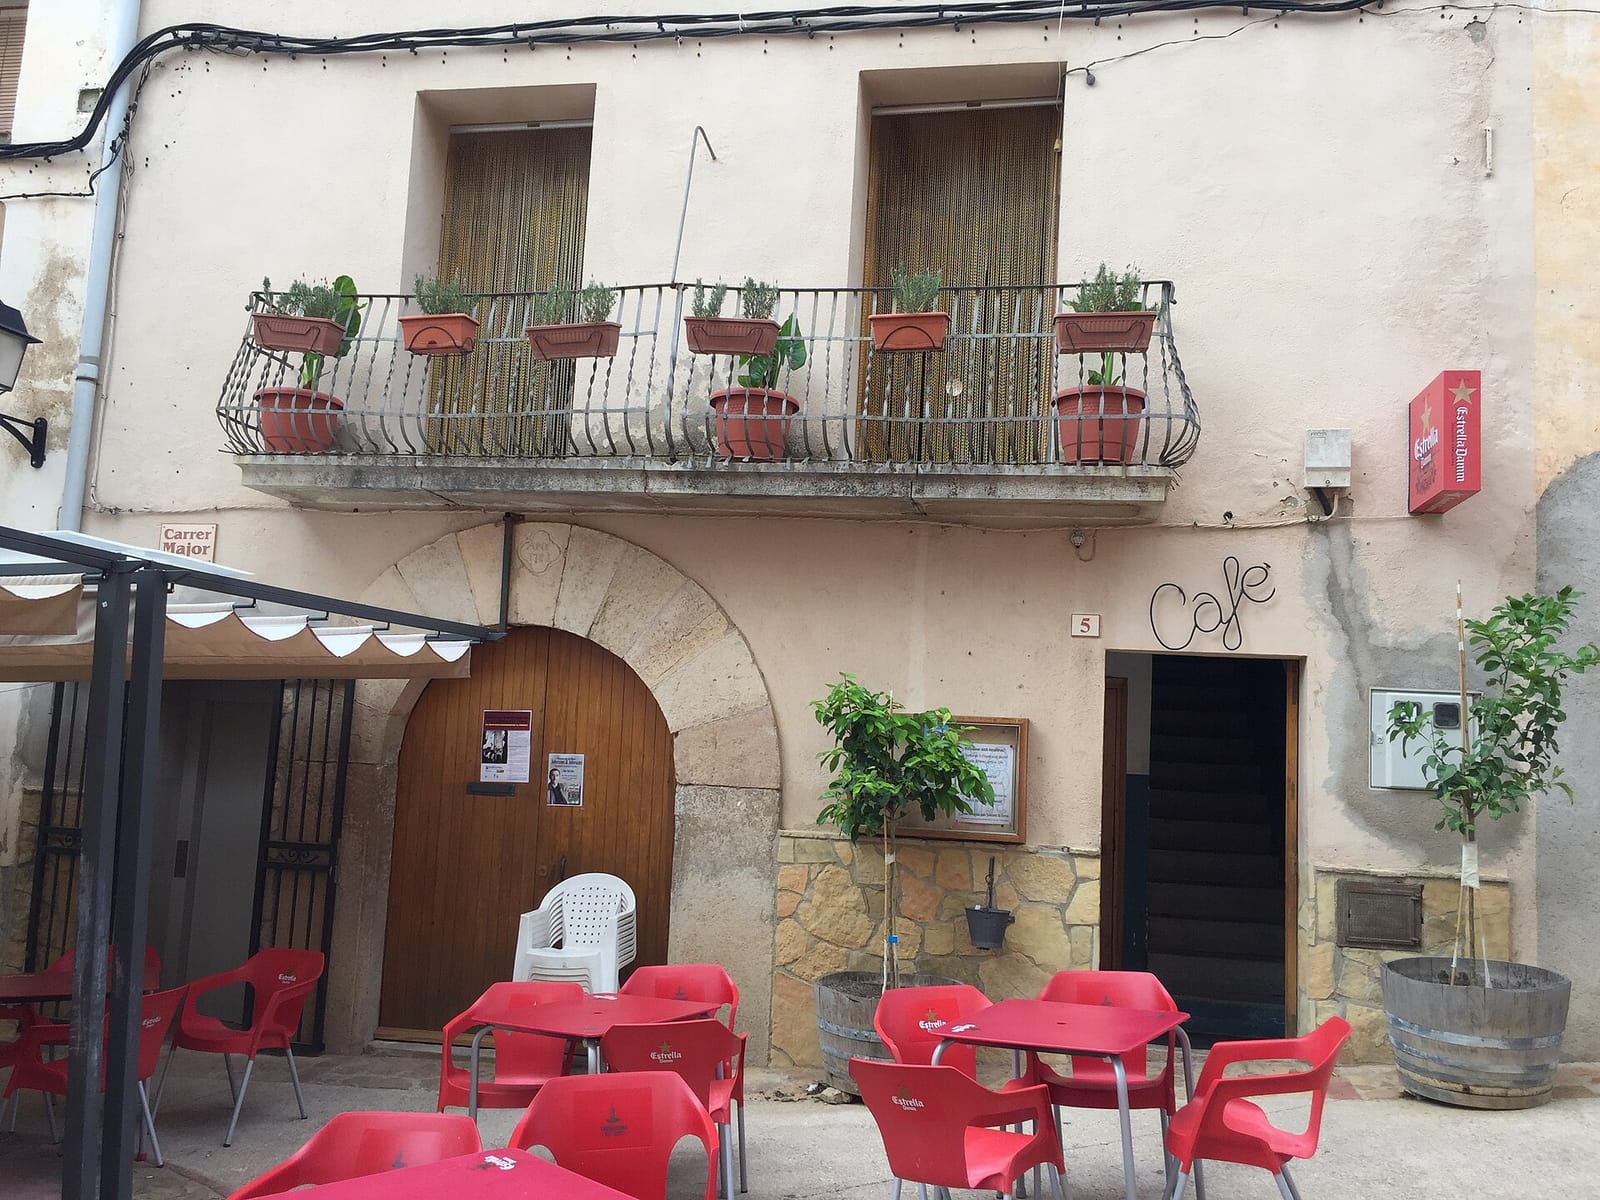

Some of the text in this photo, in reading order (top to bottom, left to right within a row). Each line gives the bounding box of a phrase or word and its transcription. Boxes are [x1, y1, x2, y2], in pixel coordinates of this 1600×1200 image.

[1414, 426, 1438, 460] Estrella
[1455, 406, 1468, 482] Estrella Damm
[163, 528, 212, 540] Carrer
[162, 541, 211, 557] Major
[1079, 617, 1091, 634] 5
[650, 1051, 682, 1060] Estrella
[891, 1095, 925, 1108] Estrella
